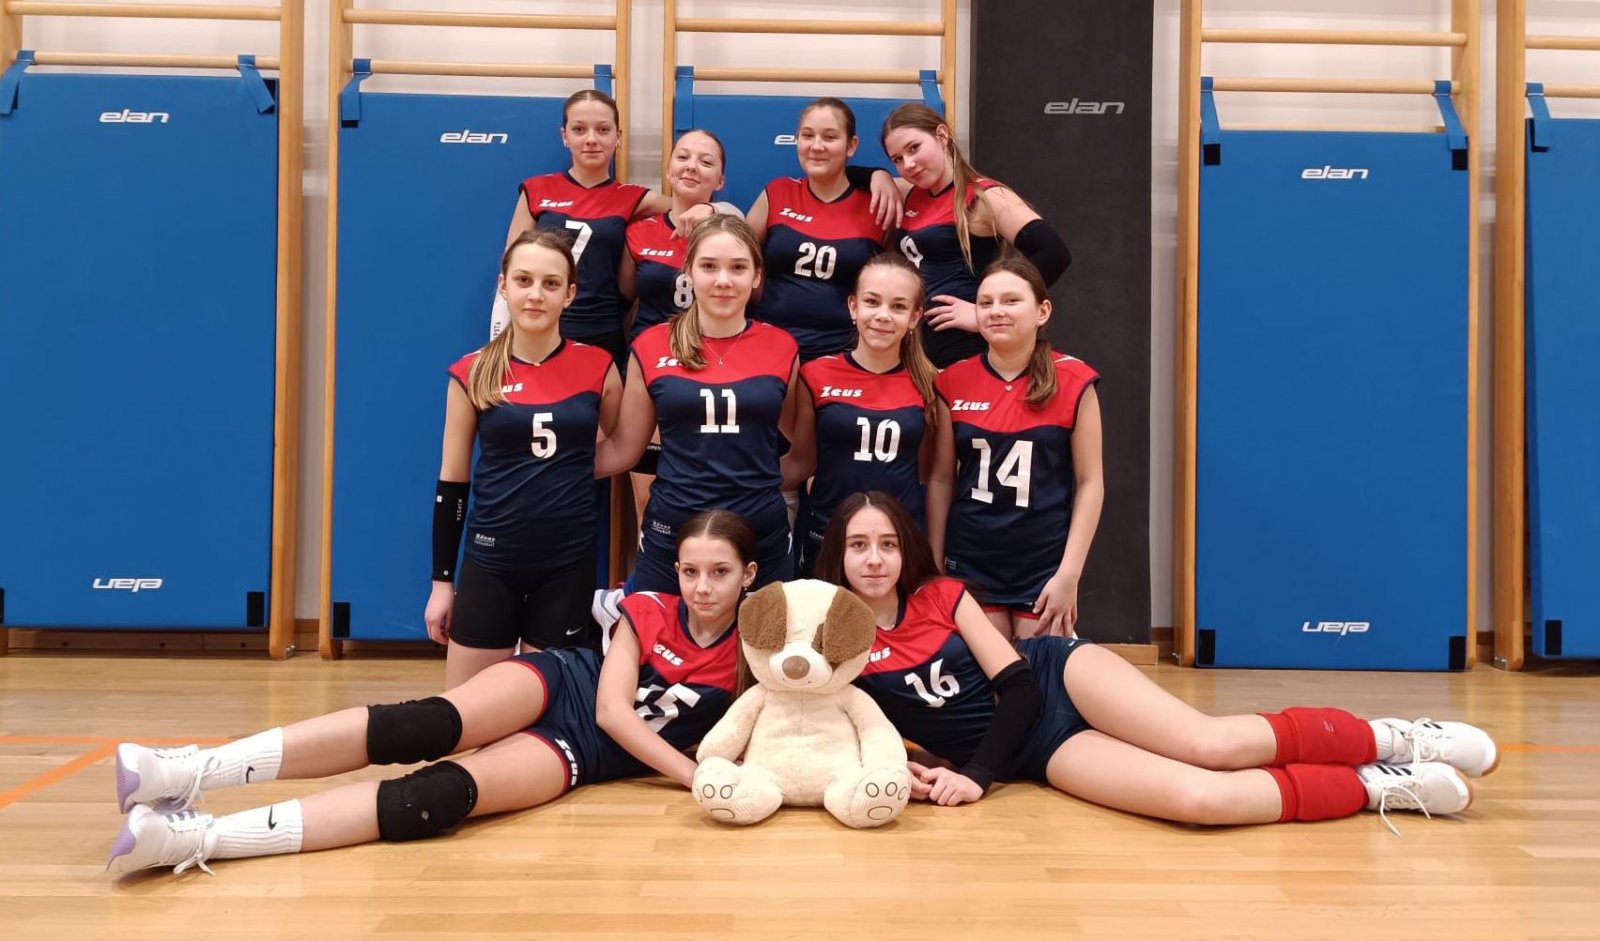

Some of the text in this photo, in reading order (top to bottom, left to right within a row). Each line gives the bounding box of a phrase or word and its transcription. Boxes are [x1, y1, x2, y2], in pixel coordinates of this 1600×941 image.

[1044, 97, 1125, 115] elan
[99, 108, 169, 124] elan
[440, 129, 508, 144] elan
[1301, 165, 1369, 180] elan
[538, 199, 574, 209] Zeus
[779, 207, 814, 223] Zeus
[564, 219, 594, 266] 7
[639, 247, 674, 257] Zeus
[795, 241, 837, 280] 20
[673, 273, 694, 310] 8
[655, 356, 682, 369] Ze
[501, 382, 524, 394] us
[821, 386, 863, 399] Zeus
[699, 388, 741, 434] 11
[951, 399, 991, 412] Zeus
[531, 412, 557, 460] 5
[853, 417, 901, 463] 10
[971, 438, 1034, 508] 14
[92, 578, 163, 593] elan
[1302, 621, 1371, 636] elan
[653, 643, 684, 666] eus
[869, 647, 891, 663] us
[904, 658, 960, 707] 16
